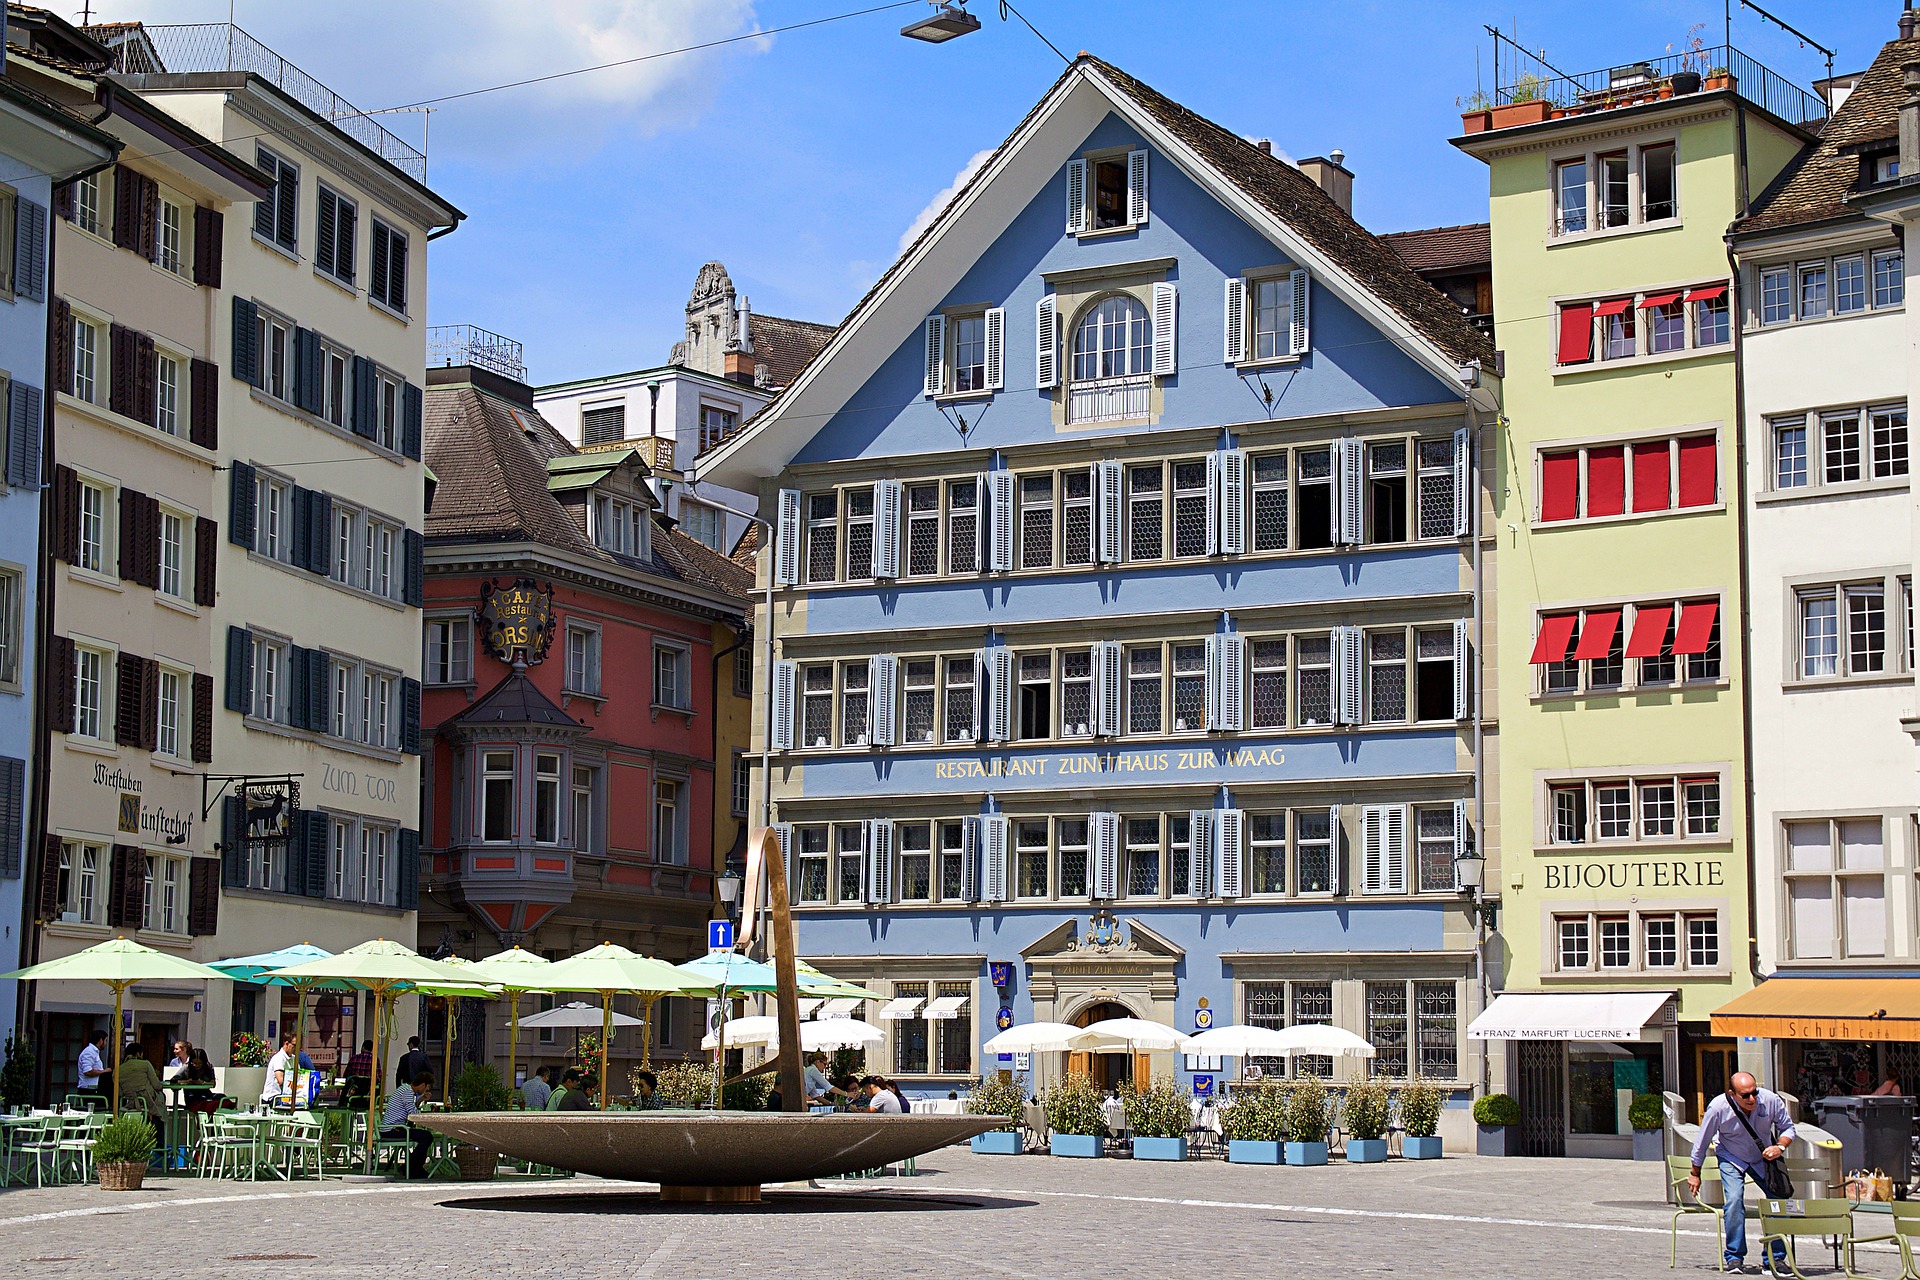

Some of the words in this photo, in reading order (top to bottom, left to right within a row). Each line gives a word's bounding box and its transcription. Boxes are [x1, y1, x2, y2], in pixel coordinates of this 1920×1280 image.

[935, 758, 1049, 779] RESTAURANT
[1059, 753, 1169, 775] ZUNFTHAUS
[1178, 751, 1216, 770] ZUR
[1226, 748, 1285, 768] WAAG
[365, 773, 396, 803] TOR
[1544, 860, 1724, 890] BIJOUTERIE
[1062, 965, 1091, 975] ZUNFT
[1094, 965, 1113, 975] ZUR
[1115, 965, 1143, 975] WAAG
[1483, 1029, 1517, 1038] FRANZ
[1521, 1029, 1569, 1038] MARFURT
[1574, 1029, 1622, 1038] LUCERNE
[1789, 1021, 1850, 1038] Schuh
[1859, 1028, 1890, 1039] Café
